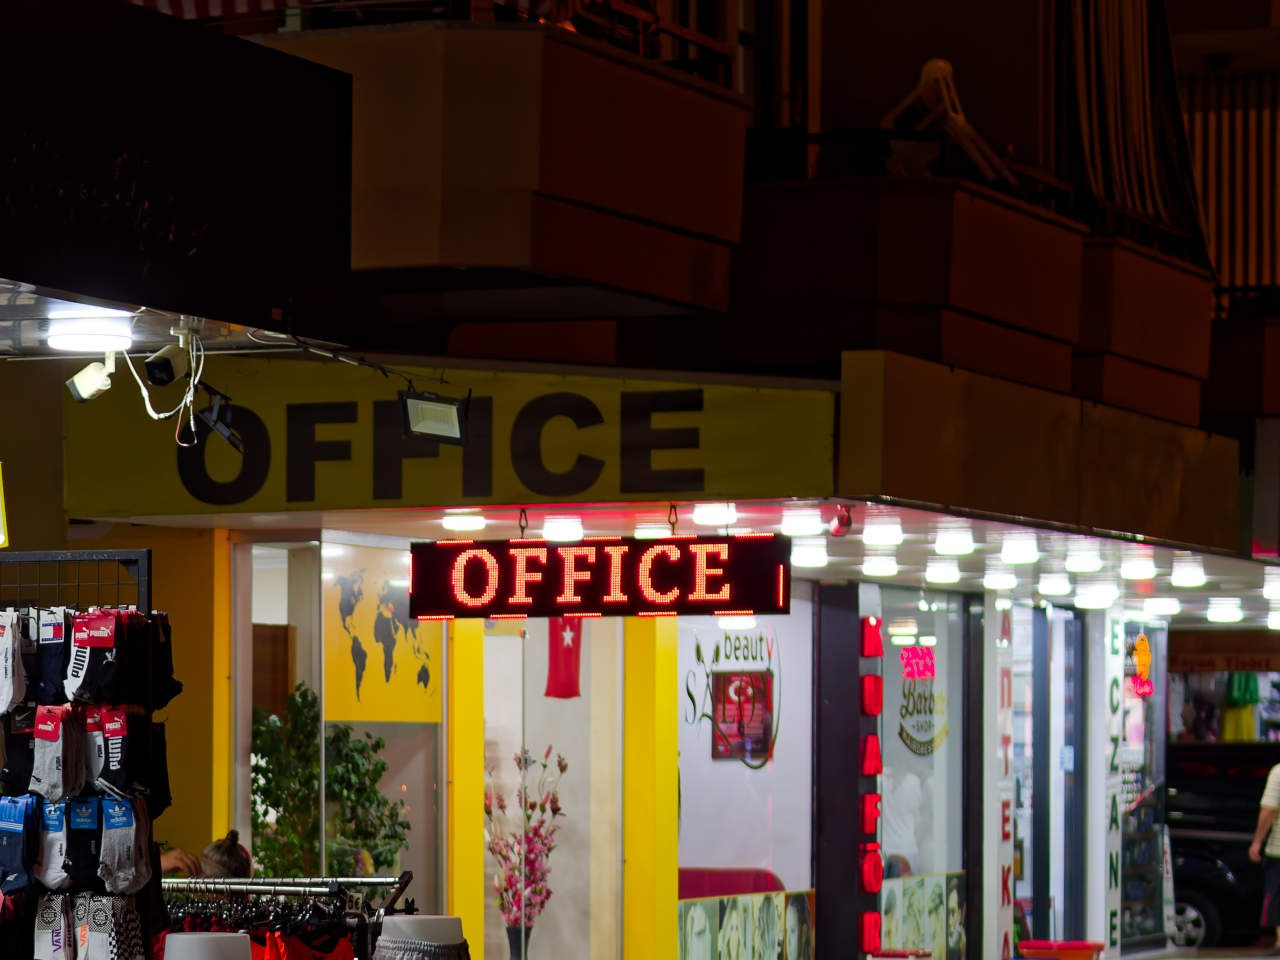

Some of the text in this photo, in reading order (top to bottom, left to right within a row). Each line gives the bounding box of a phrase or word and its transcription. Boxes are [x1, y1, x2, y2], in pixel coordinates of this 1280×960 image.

[177, 389, 705, 505] OFFICE
[451, 543, 731, 606] OFFICE
[724, 630, 774, 668] beauty
